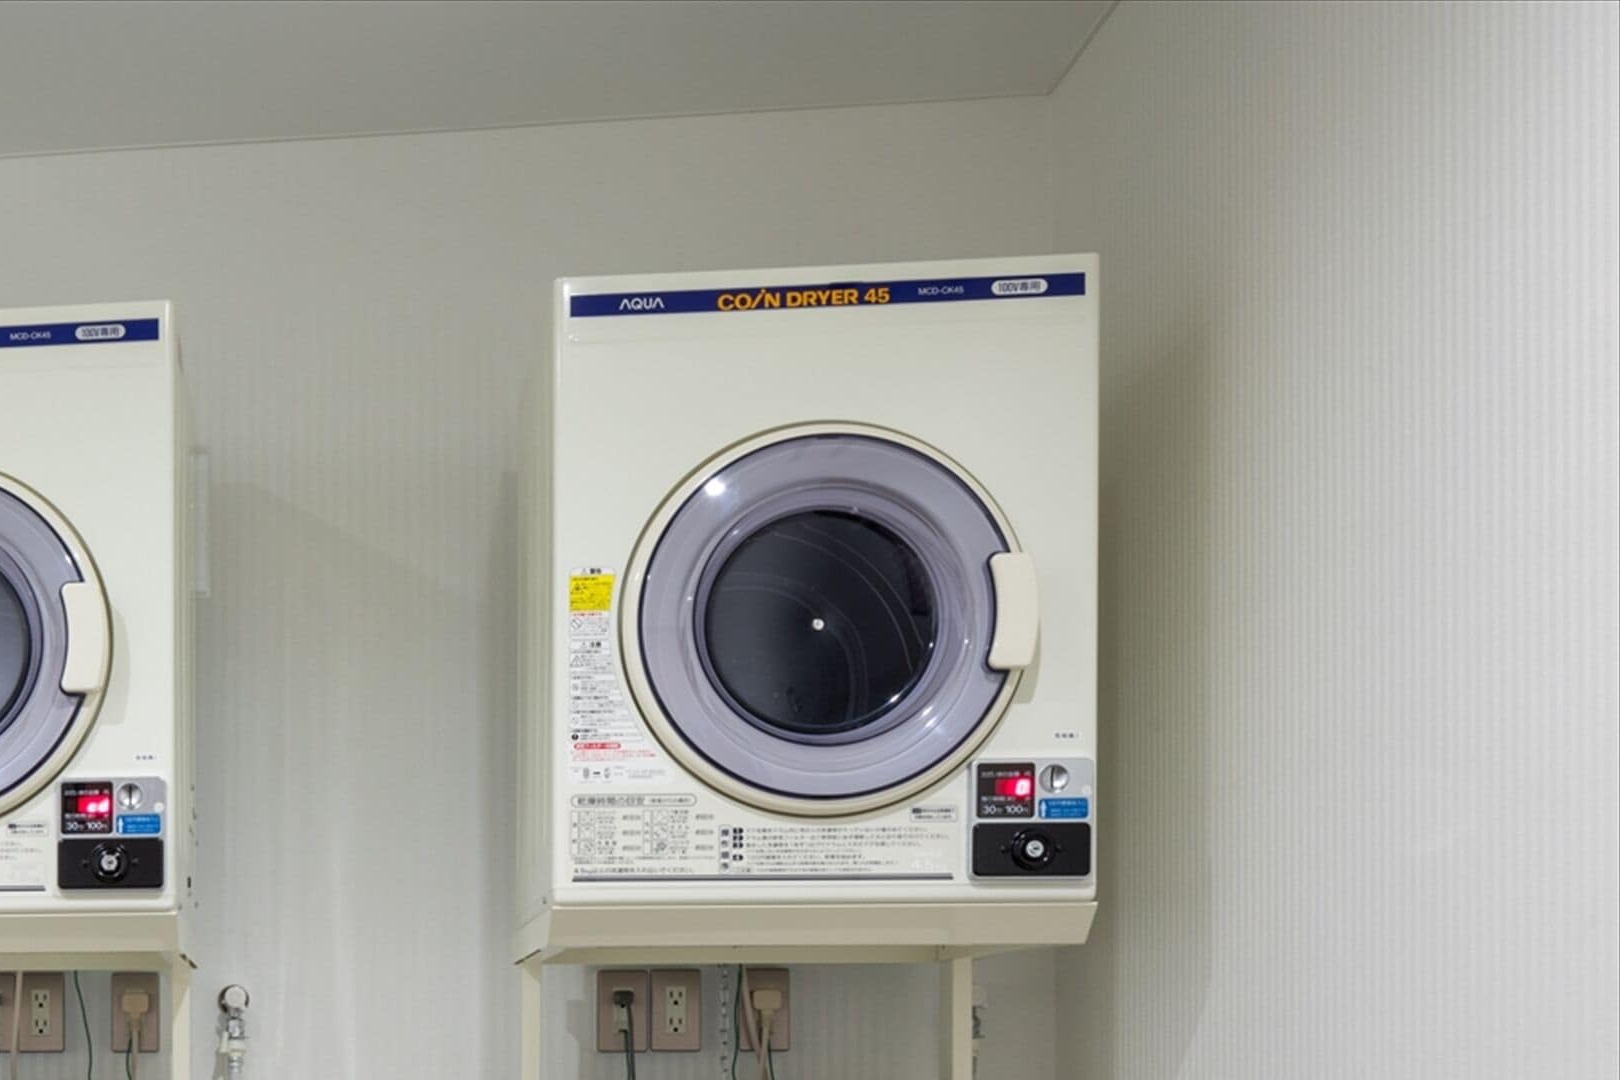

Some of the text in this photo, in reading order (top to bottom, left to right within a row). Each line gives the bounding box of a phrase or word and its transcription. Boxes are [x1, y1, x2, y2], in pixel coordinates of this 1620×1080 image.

[619, 298, 665, 311] AQUA
[786, 289, 859, 308] DRYER
[864, 287, 890, 304] 45
